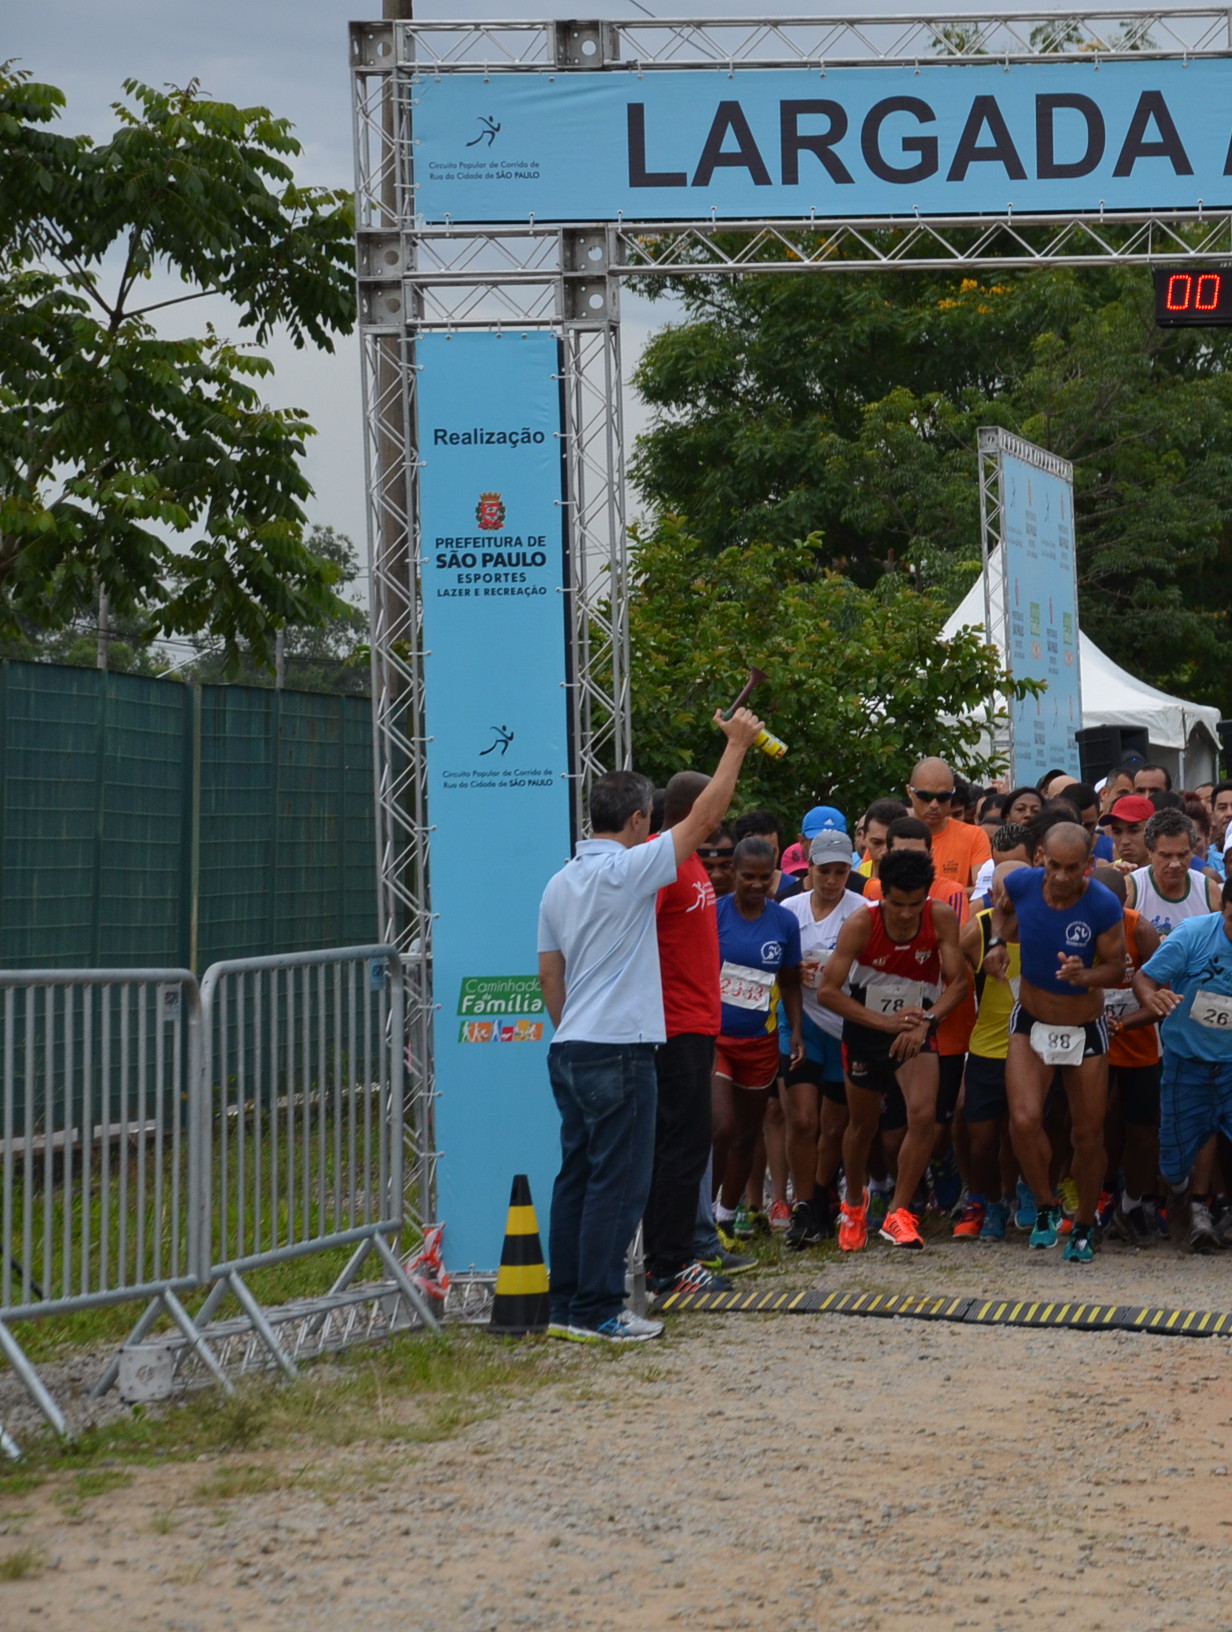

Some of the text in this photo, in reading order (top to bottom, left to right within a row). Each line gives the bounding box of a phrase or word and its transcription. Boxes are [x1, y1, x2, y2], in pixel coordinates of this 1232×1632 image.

[627, 90, 1194, 187] LARGADA
[428, 160, 540, 170] Circuito Popular de Corrida de
[429, 170, 540, 180] Rua da Cidade de SÃO PAULO
[1166, 274, 1221, 310] 00
[434, 428, 544, 448] Realização
[436, 536, 546, 548] PREFEITURA DE
[436, 550, 546, 568] SÃO PAULO
[457, 571, 527, 584] ESPORTES
[437, 585, 546, 598] LAZER E RECREAÇÃO
[441, 768, 553, 779] Circuito Popular de Corrida de
[443, 778, 553, 789] Rua da Cidade de SÃO PAULO
[461, 993, 542, 1014] Família
[880, 998, 905, 1013] 78
[1203, 1008, 1230, 1026] 26
[1048, 1032, 1072, 1050] 88
